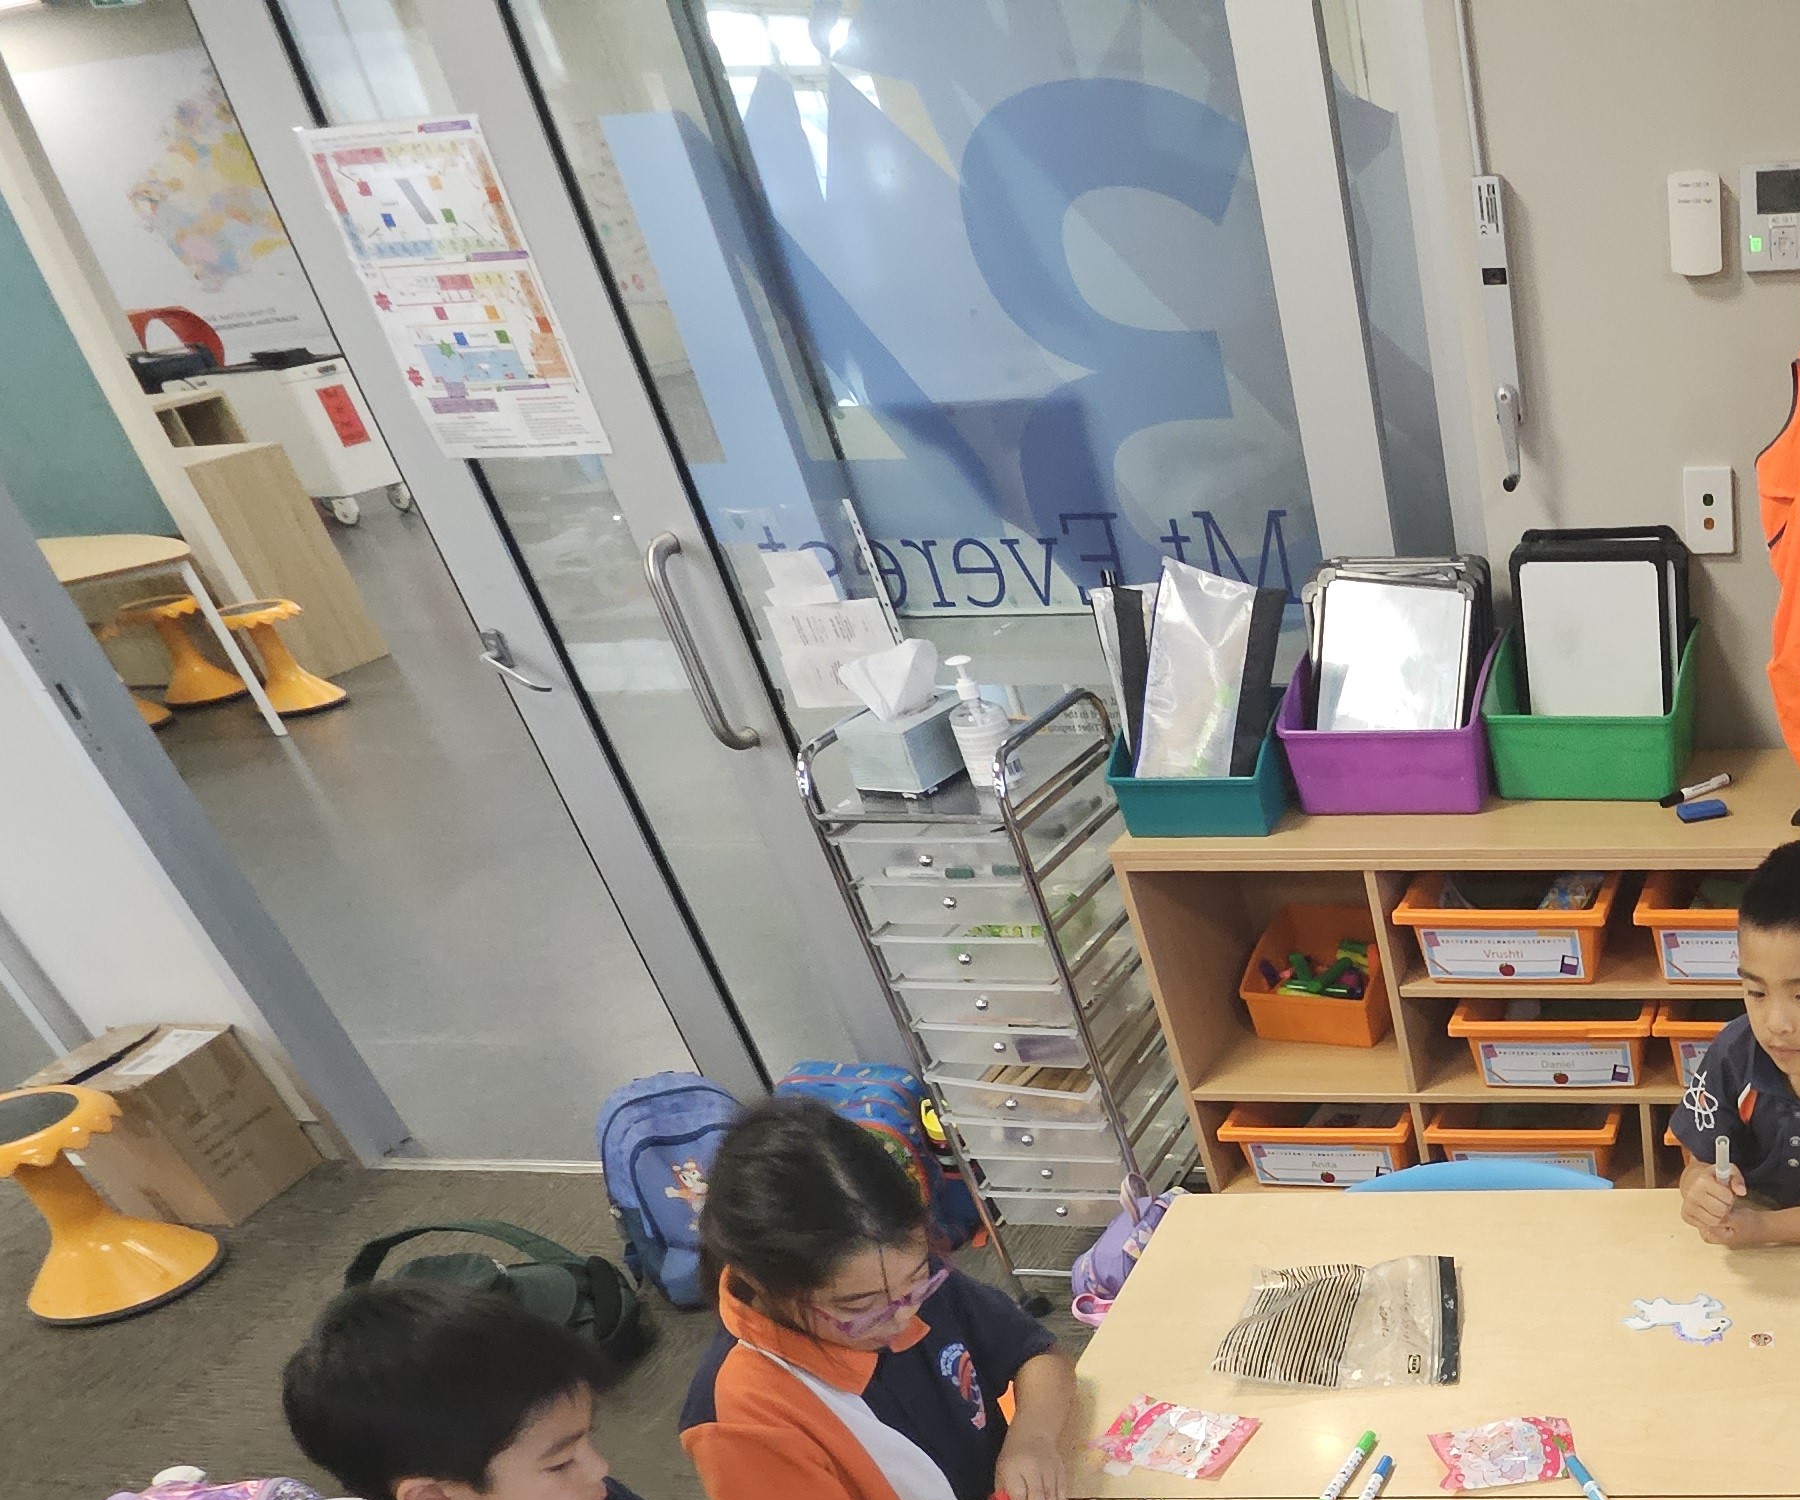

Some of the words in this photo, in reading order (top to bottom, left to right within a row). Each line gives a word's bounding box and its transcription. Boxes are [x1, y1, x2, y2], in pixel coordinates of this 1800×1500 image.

[1483, 949, 1524, 960] Vrushti
[1541, 1060, 1575, 1069] Daniel
[1311, 1160, 1338, 1169] Anita
